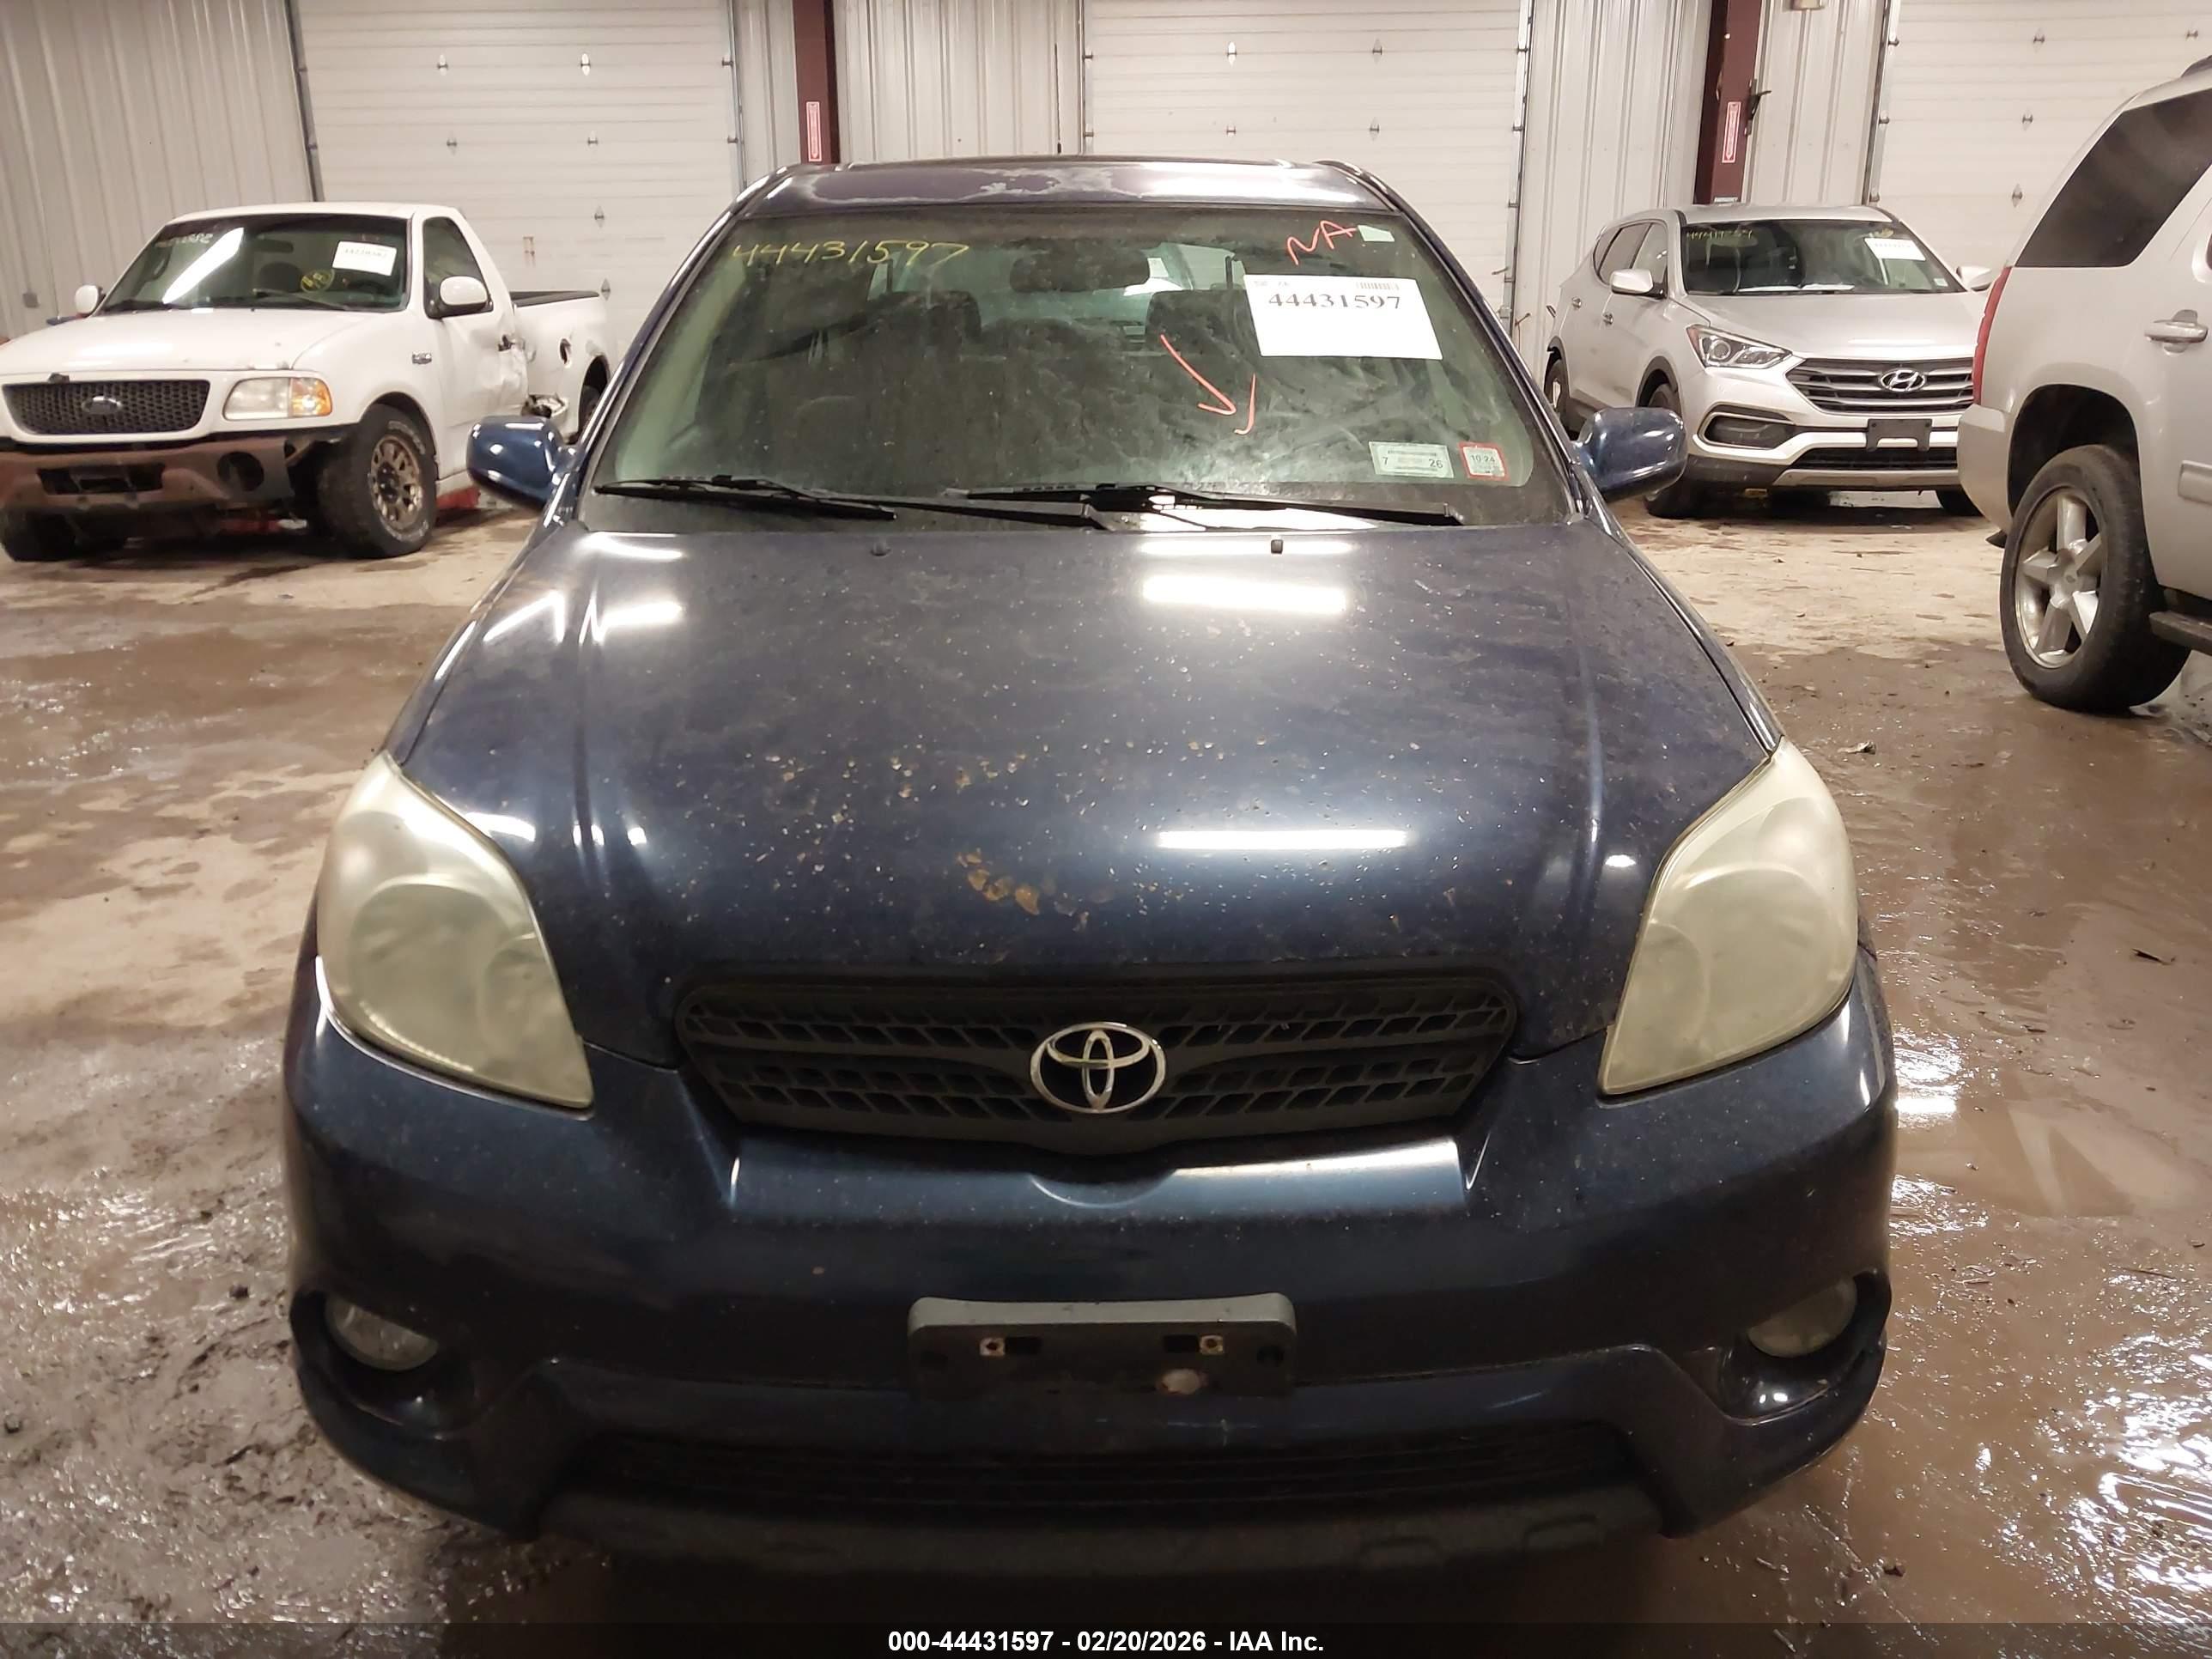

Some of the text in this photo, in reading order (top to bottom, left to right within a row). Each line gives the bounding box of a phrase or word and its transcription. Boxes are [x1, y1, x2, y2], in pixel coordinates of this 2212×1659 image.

[732, 240, 969, 267] 44431597
[1268, 293, 1401, 310] 44431597
[1382, 456, 1444, 469] 7 26
